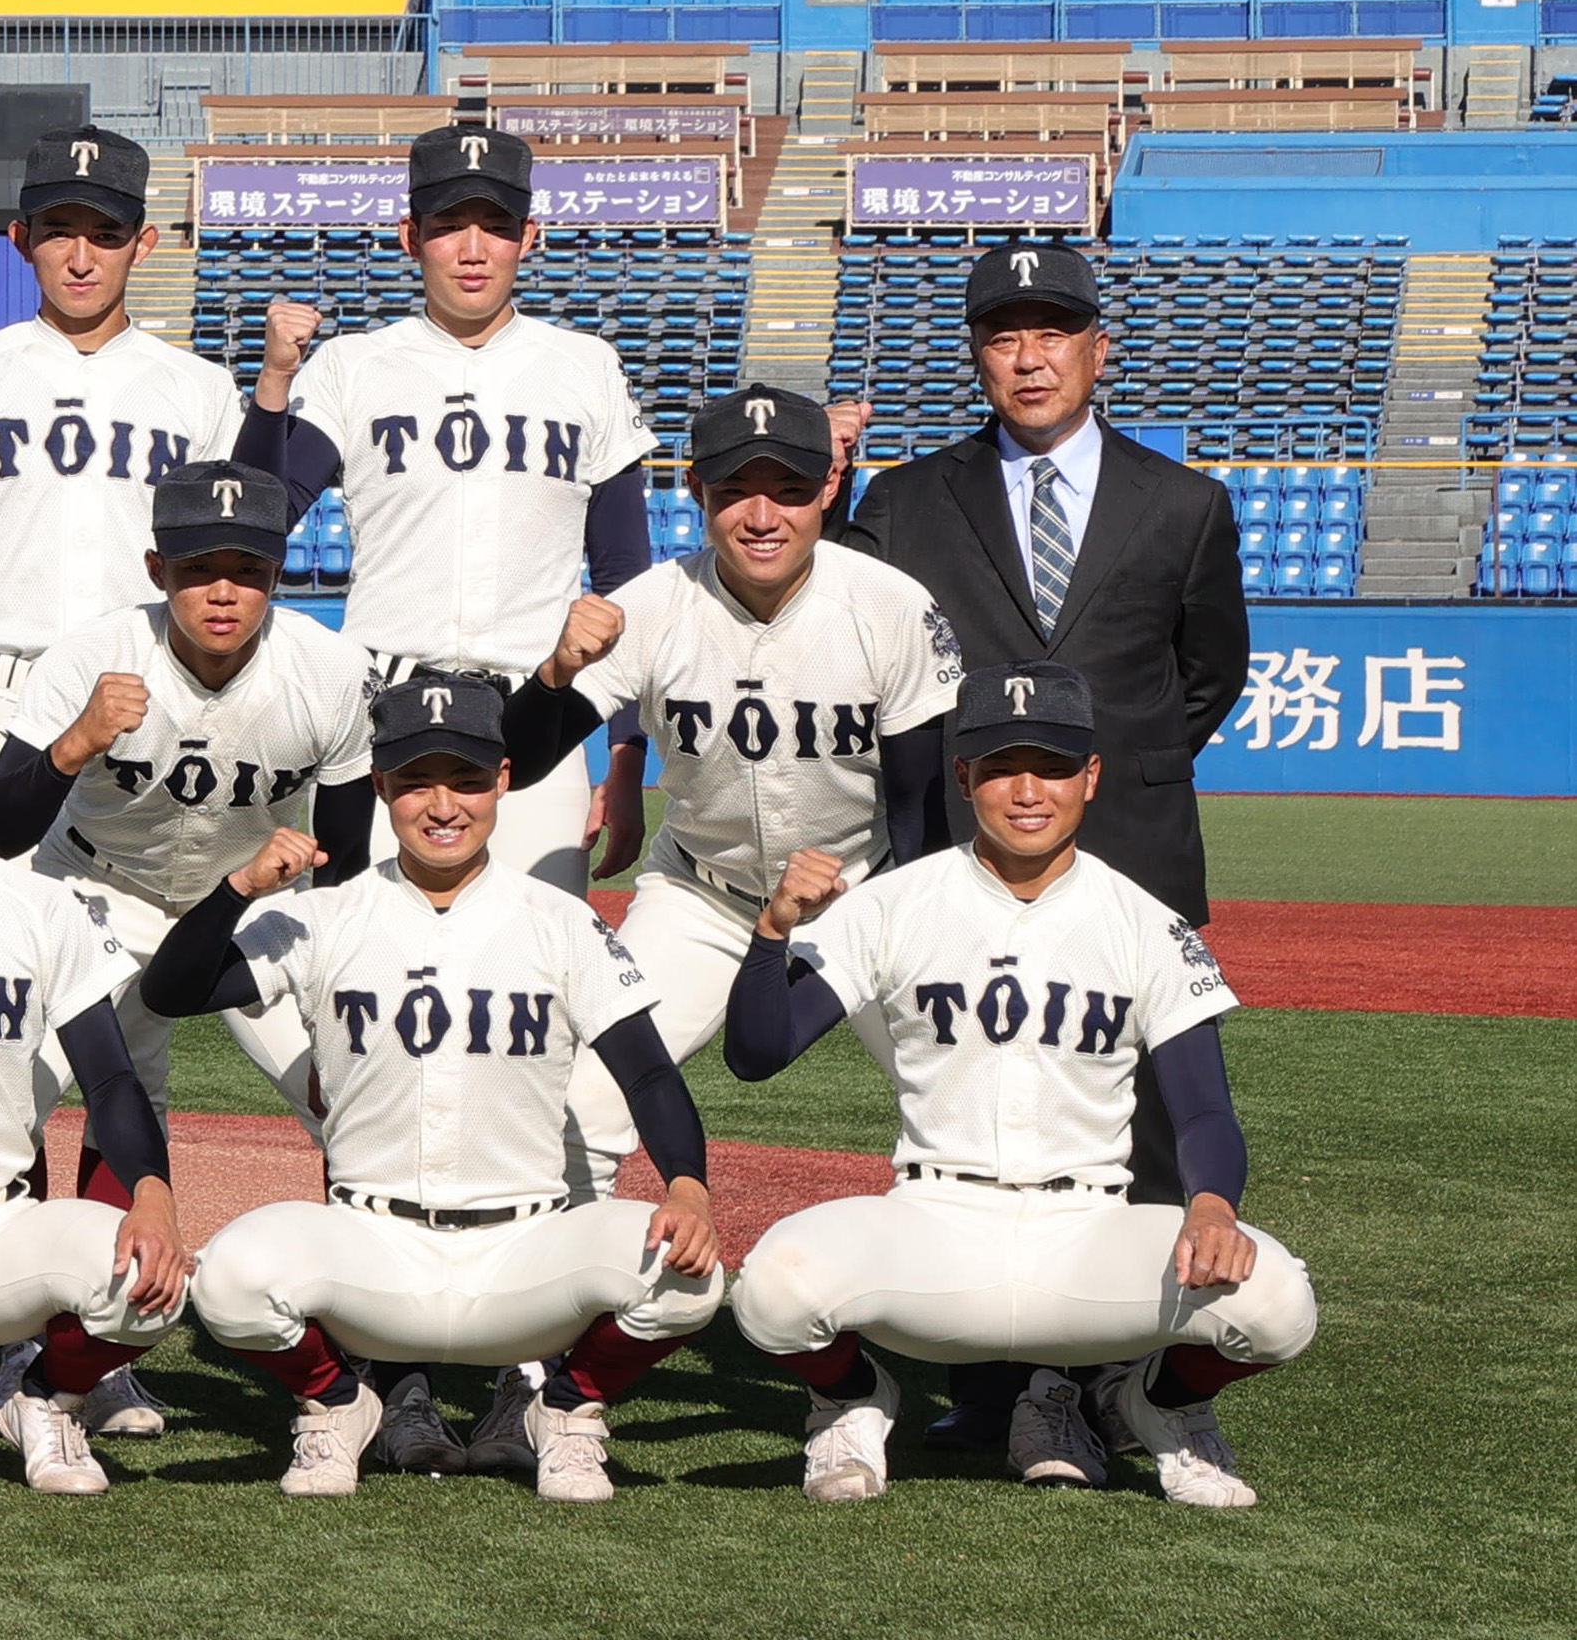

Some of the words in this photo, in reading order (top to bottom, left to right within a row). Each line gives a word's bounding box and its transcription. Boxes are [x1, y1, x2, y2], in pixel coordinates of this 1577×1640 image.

[506, 118, 610, 133] 環境ステーション
[624, 117, 730, 132] 環境ステーション
[459, 134, 489, 171] T
[531, 188, 710, 215] 境ステーション
[861, 187, 1079, 215] 環境ステーション
[1008, 251, 1039, 288] T
[1208, 647, 1467, 751] 務店
